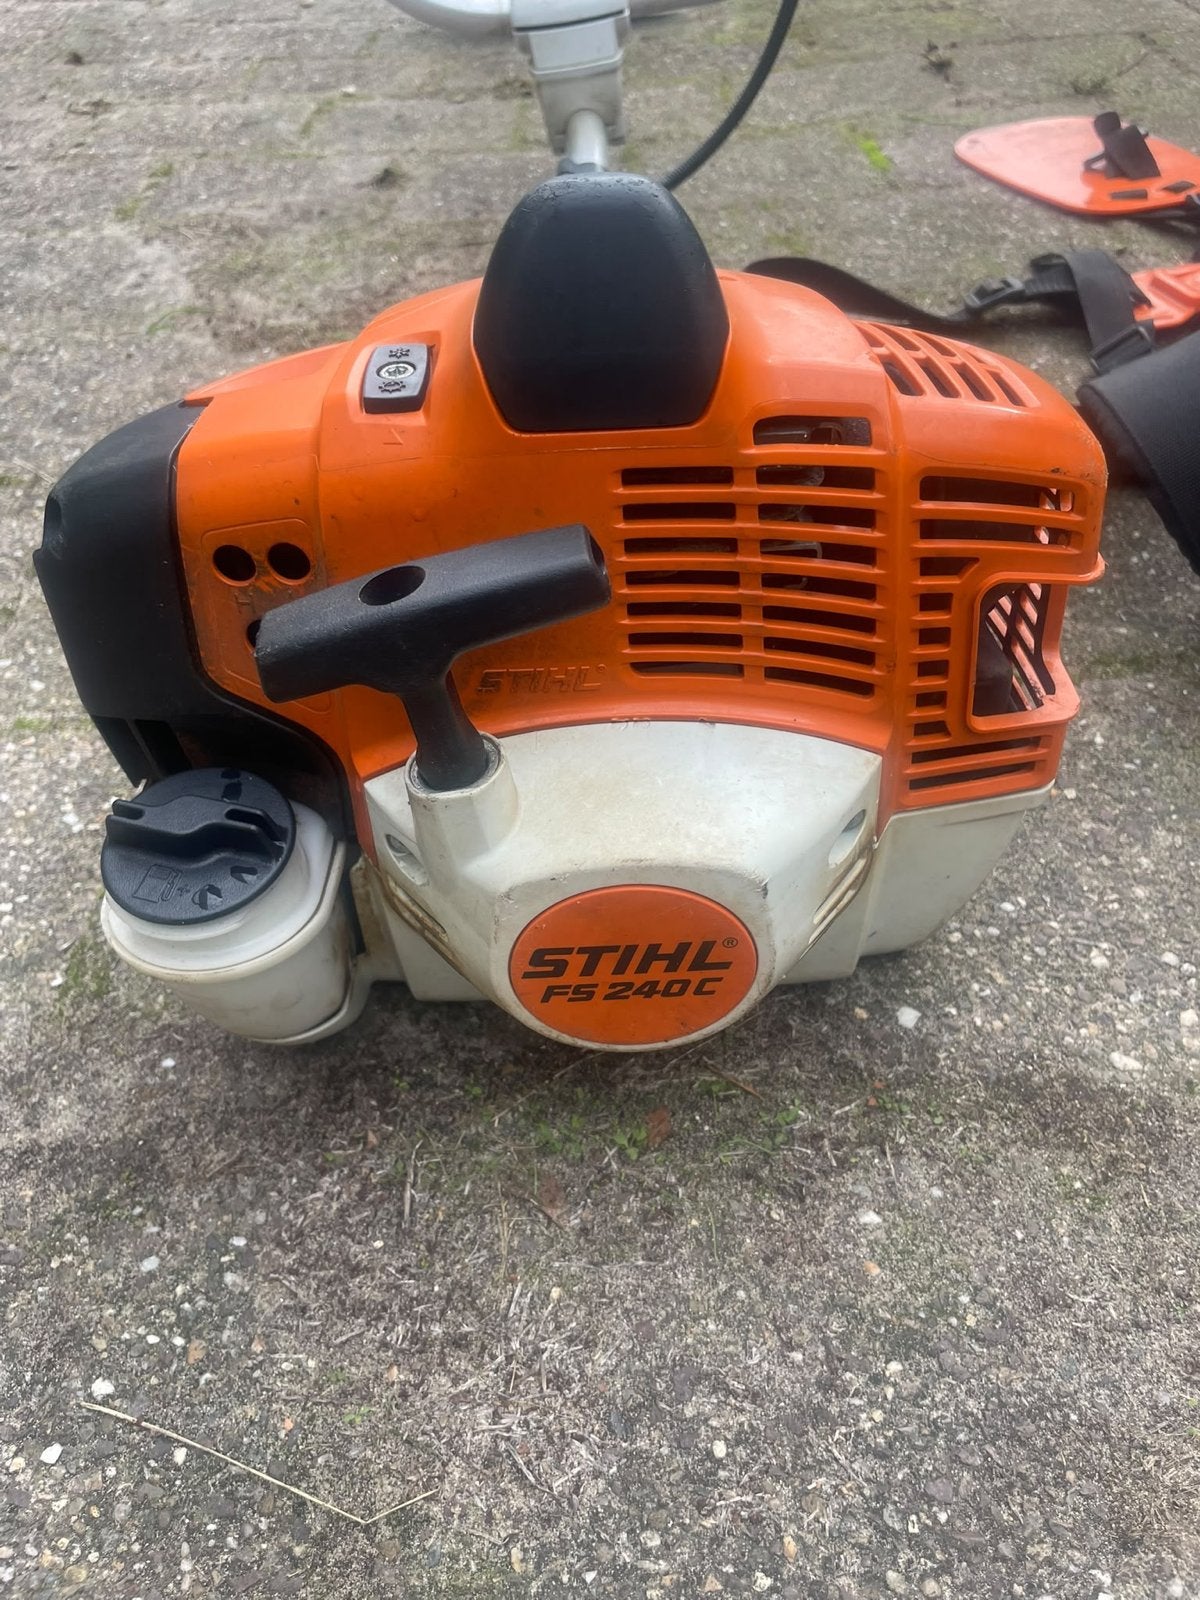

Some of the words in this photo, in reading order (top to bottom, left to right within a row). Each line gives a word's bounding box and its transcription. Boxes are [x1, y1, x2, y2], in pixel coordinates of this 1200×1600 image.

[476, 666, 602, 693] STIHL
[521, 940, 733, 979] STIHL
[540, 983, 599, 1004] FS
